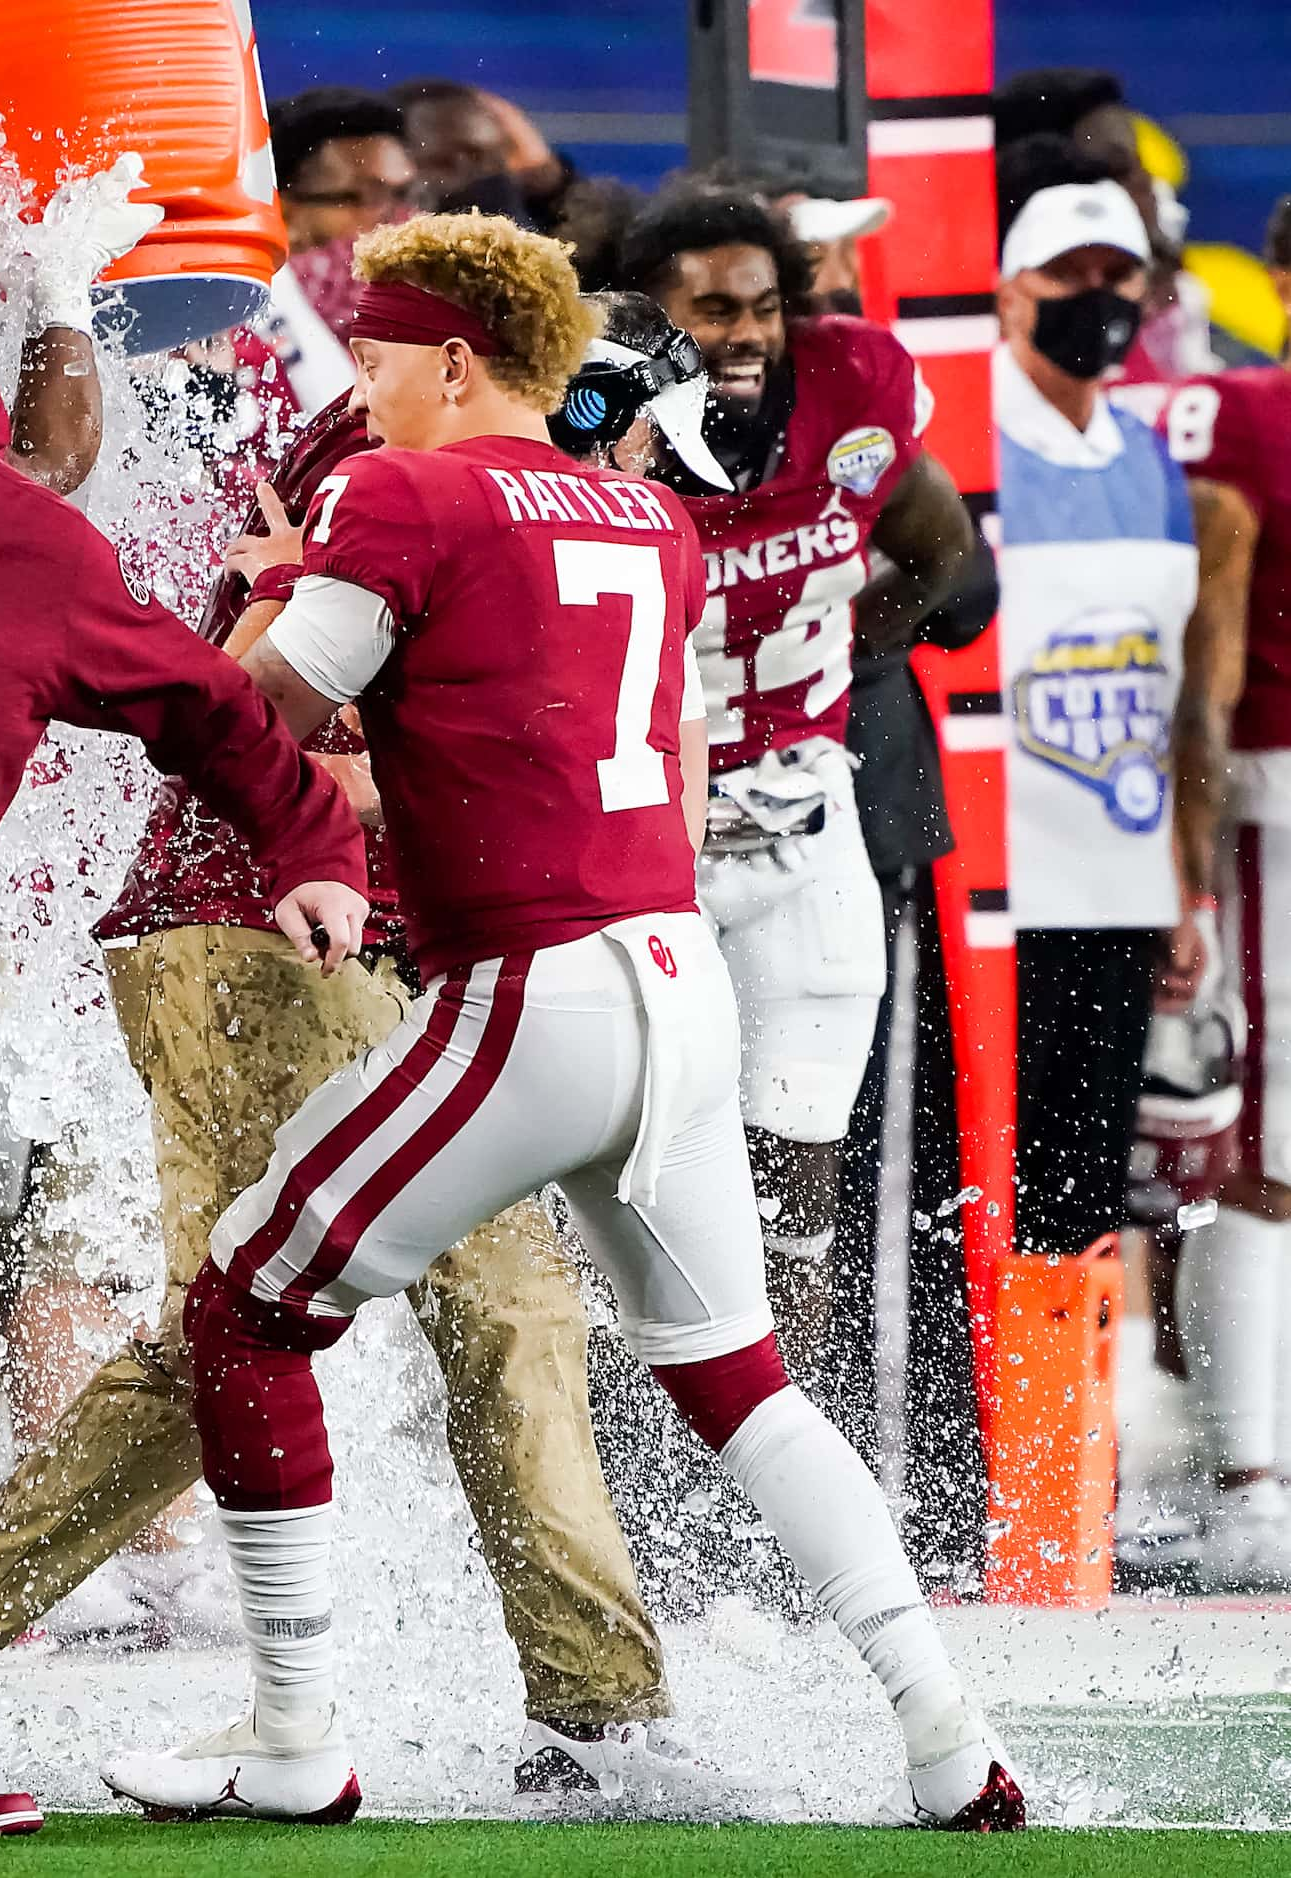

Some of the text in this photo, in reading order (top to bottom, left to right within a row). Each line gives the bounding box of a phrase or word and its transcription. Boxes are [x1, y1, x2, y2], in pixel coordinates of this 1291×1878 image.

[311, 474, 351, 545] 7
[485, 467, 674, 531] RATTLER
[552, 539, 671, 813] 7
